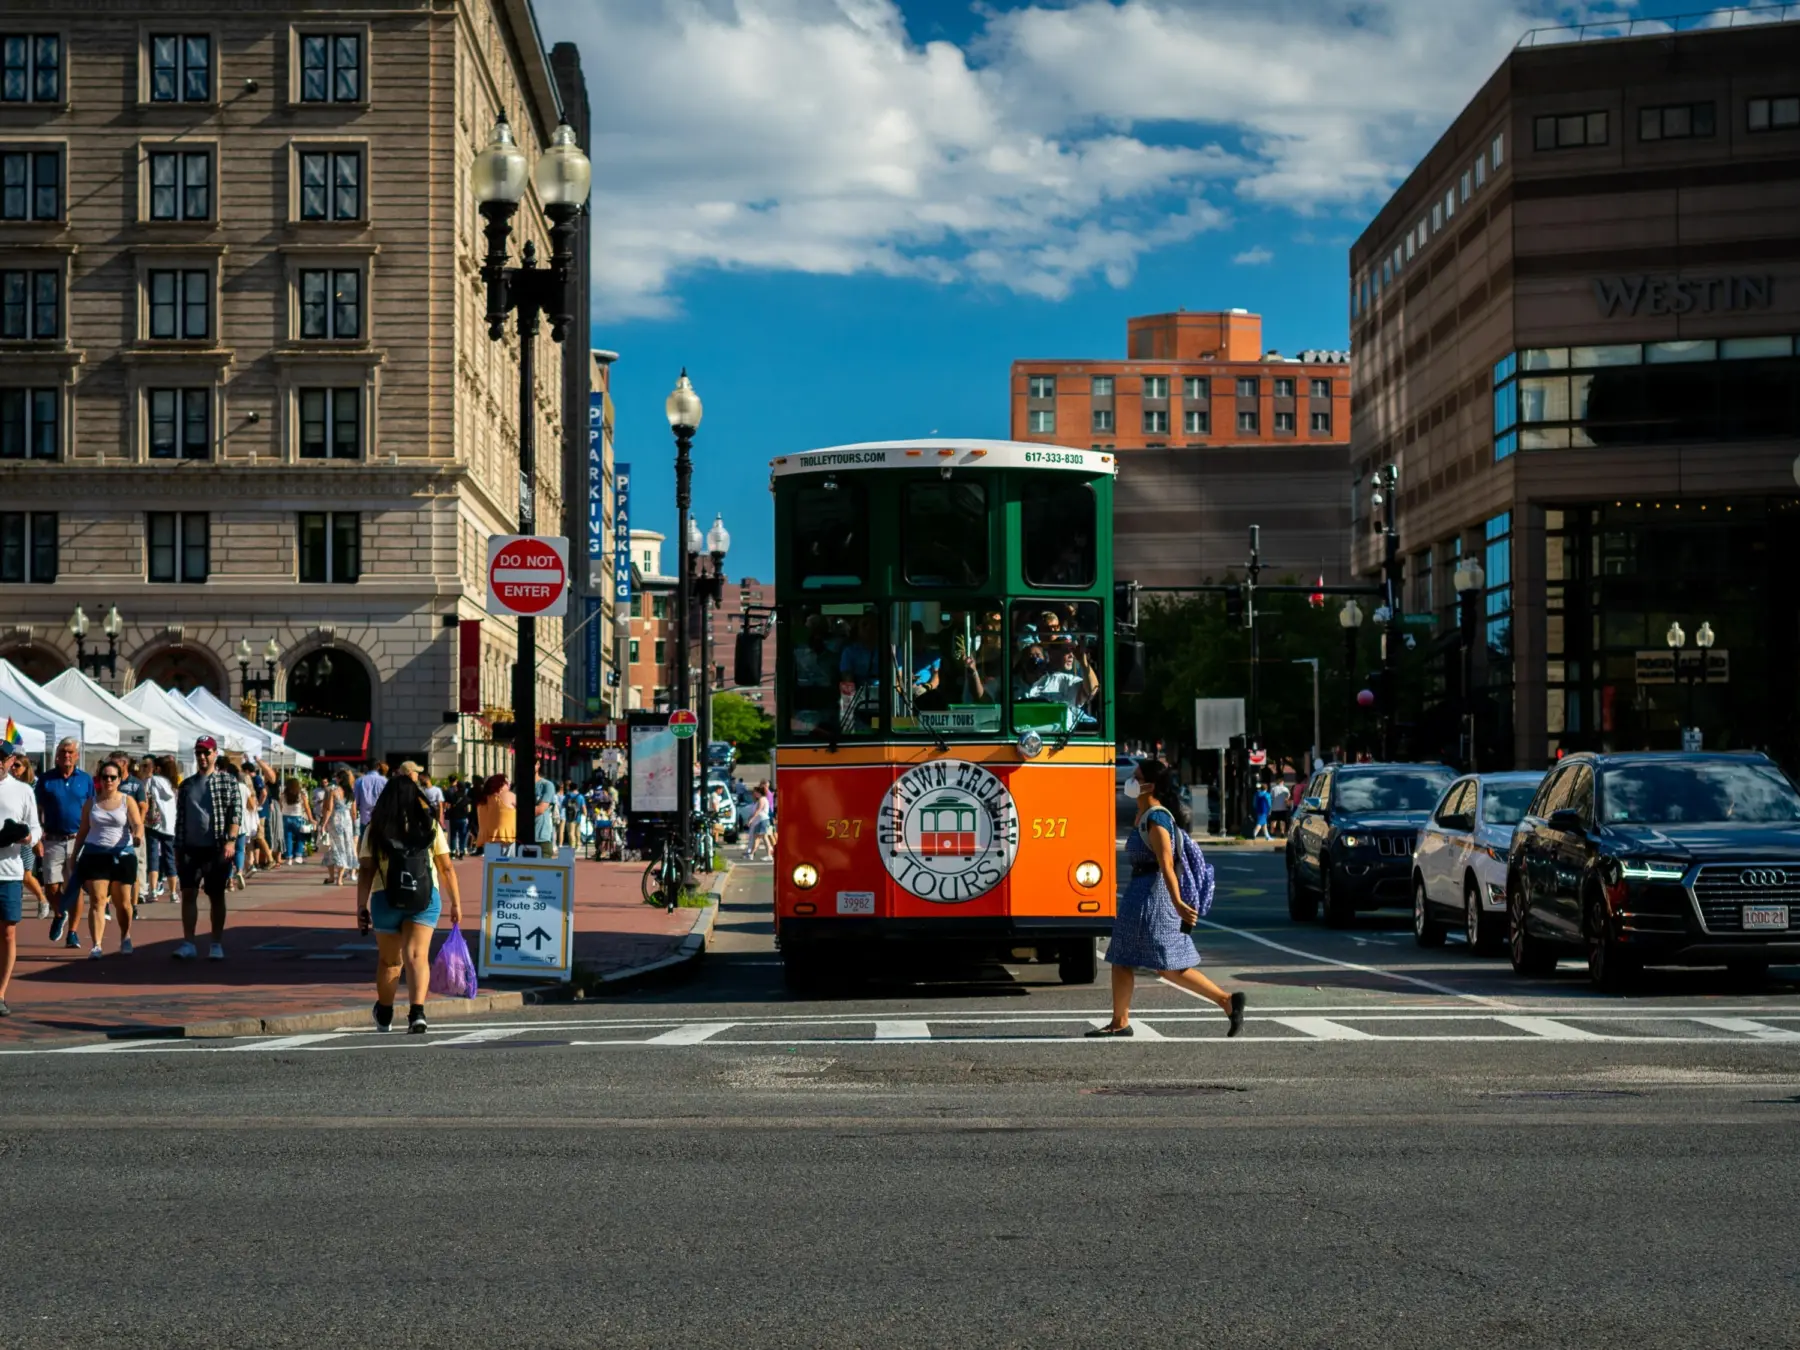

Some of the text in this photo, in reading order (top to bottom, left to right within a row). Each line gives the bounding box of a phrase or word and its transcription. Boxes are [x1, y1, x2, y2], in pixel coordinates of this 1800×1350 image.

[1594, 275, 1776, 318] WESTIN
[800, 451, 886, 468] TROLLEYTOURS.COM
[1025, 451, 1084, 465] 617-333-8303
[589, 430, 600, 553] PARKING
[617, 476, 628, 490] P
[617, 495, 628, 597] PARKING
[500, 554, 556, 568] DO NOT
[504, 585, 550, 597] ENTER
[922, 714, 975, 726] TROLLEY TOURS
[879, 761, 1017, 846] OLD TOWN TROLLEY
[826, 819, 863, 839] 527
[1031, 818, 1068, 839] 527
[897, 855, 1002, 901] TOURS
[497, 900, 547, 911] Route 39
[497, 910, 521, 920] Bus.
